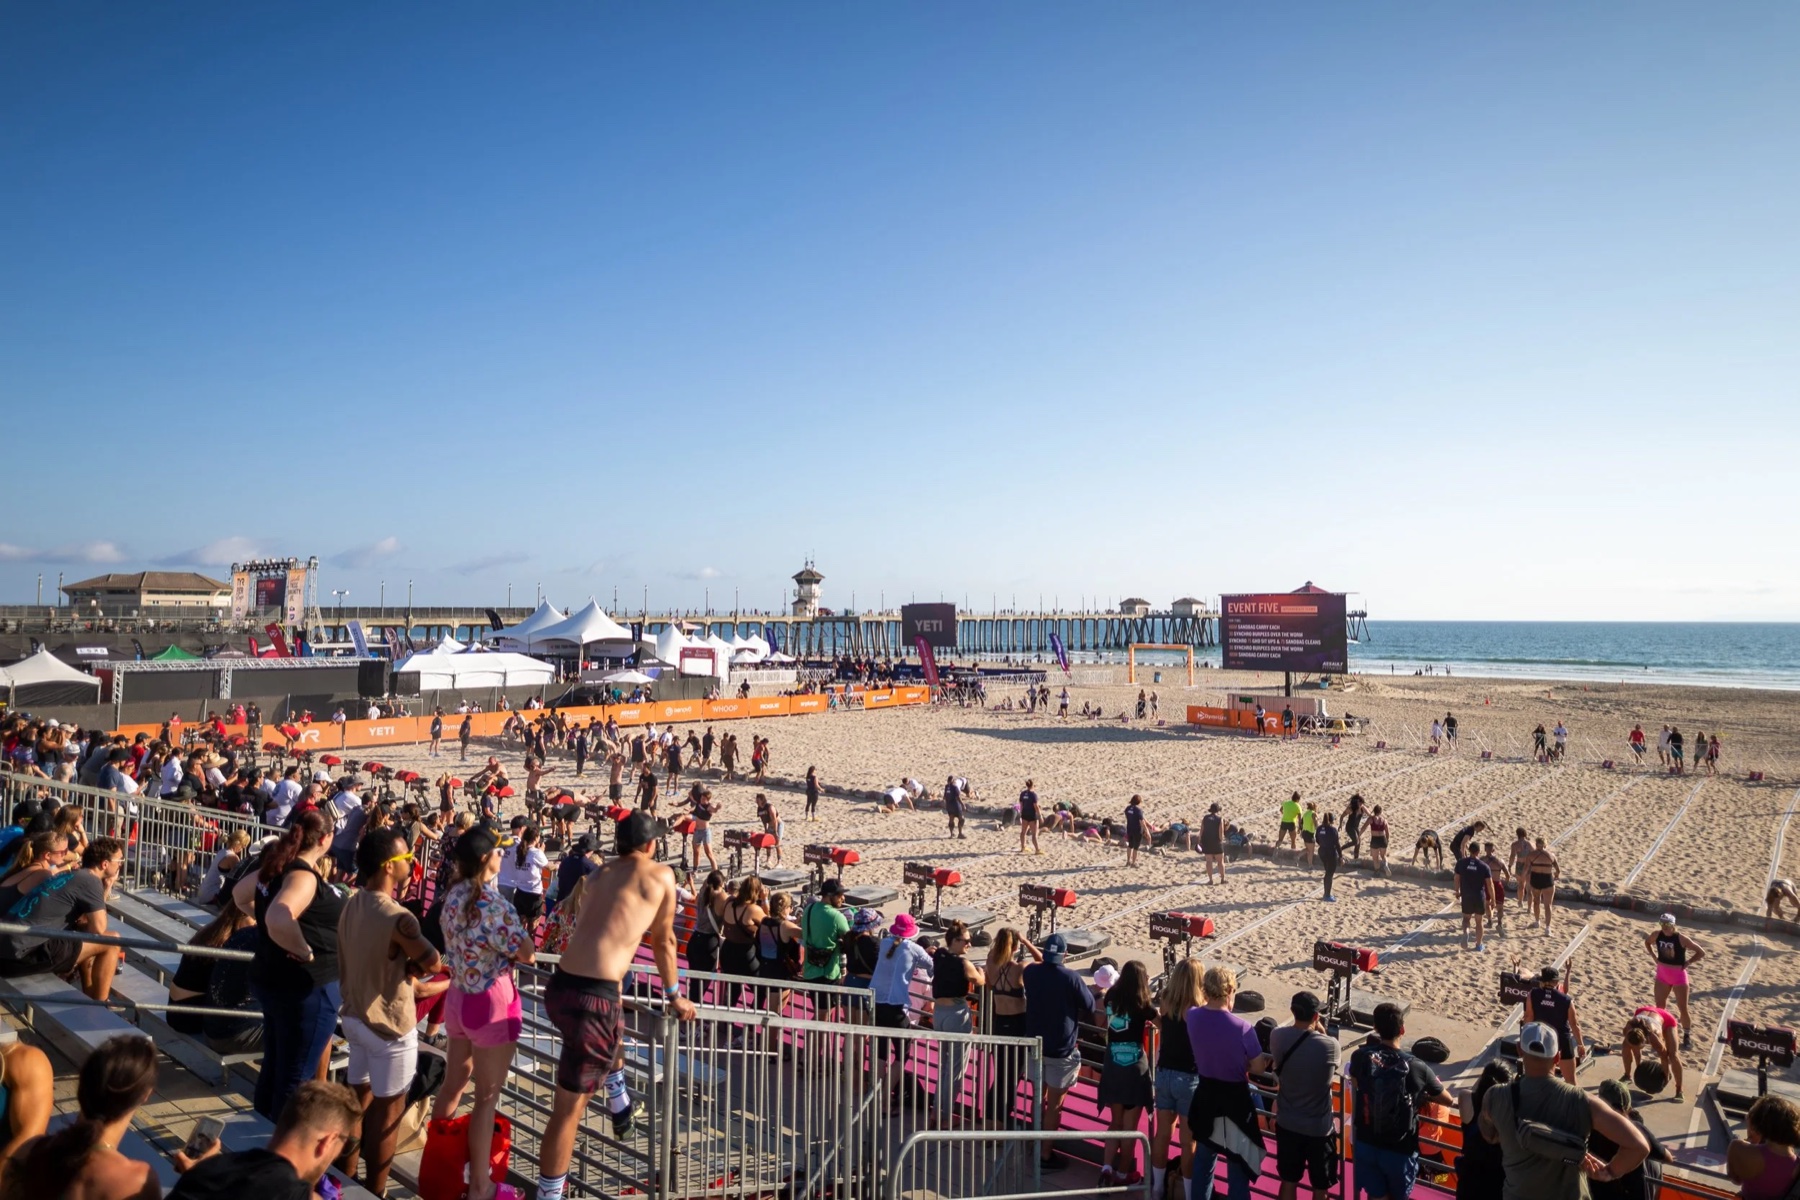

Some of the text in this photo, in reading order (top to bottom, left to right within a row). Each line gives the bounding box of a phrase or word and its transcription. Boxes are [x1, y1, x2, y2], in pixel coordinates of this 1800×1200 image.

[1228, 602, 1256, 613] EVENT
[1258, 602, 1279, 613] FIVE
[914, 620, 942, 632] YETI
[712, 704, 739, 713] WHOOP
[368, 725, 395, 736] YETI
[805, 852, 821, 860] ROGUE
[905, 871, 925, 881] ROGUE
[1021, 893, 1044, 903] ROGUE
[1152, 924, 1179, 935] ROGUE
[1659, 940, 1675, 949] TYR
[1317, 954, 1348, 967] ROGUE
[1504, 986, 1530, 998] ROG
[1738, 1038, 1786, 1055] ROGUE
